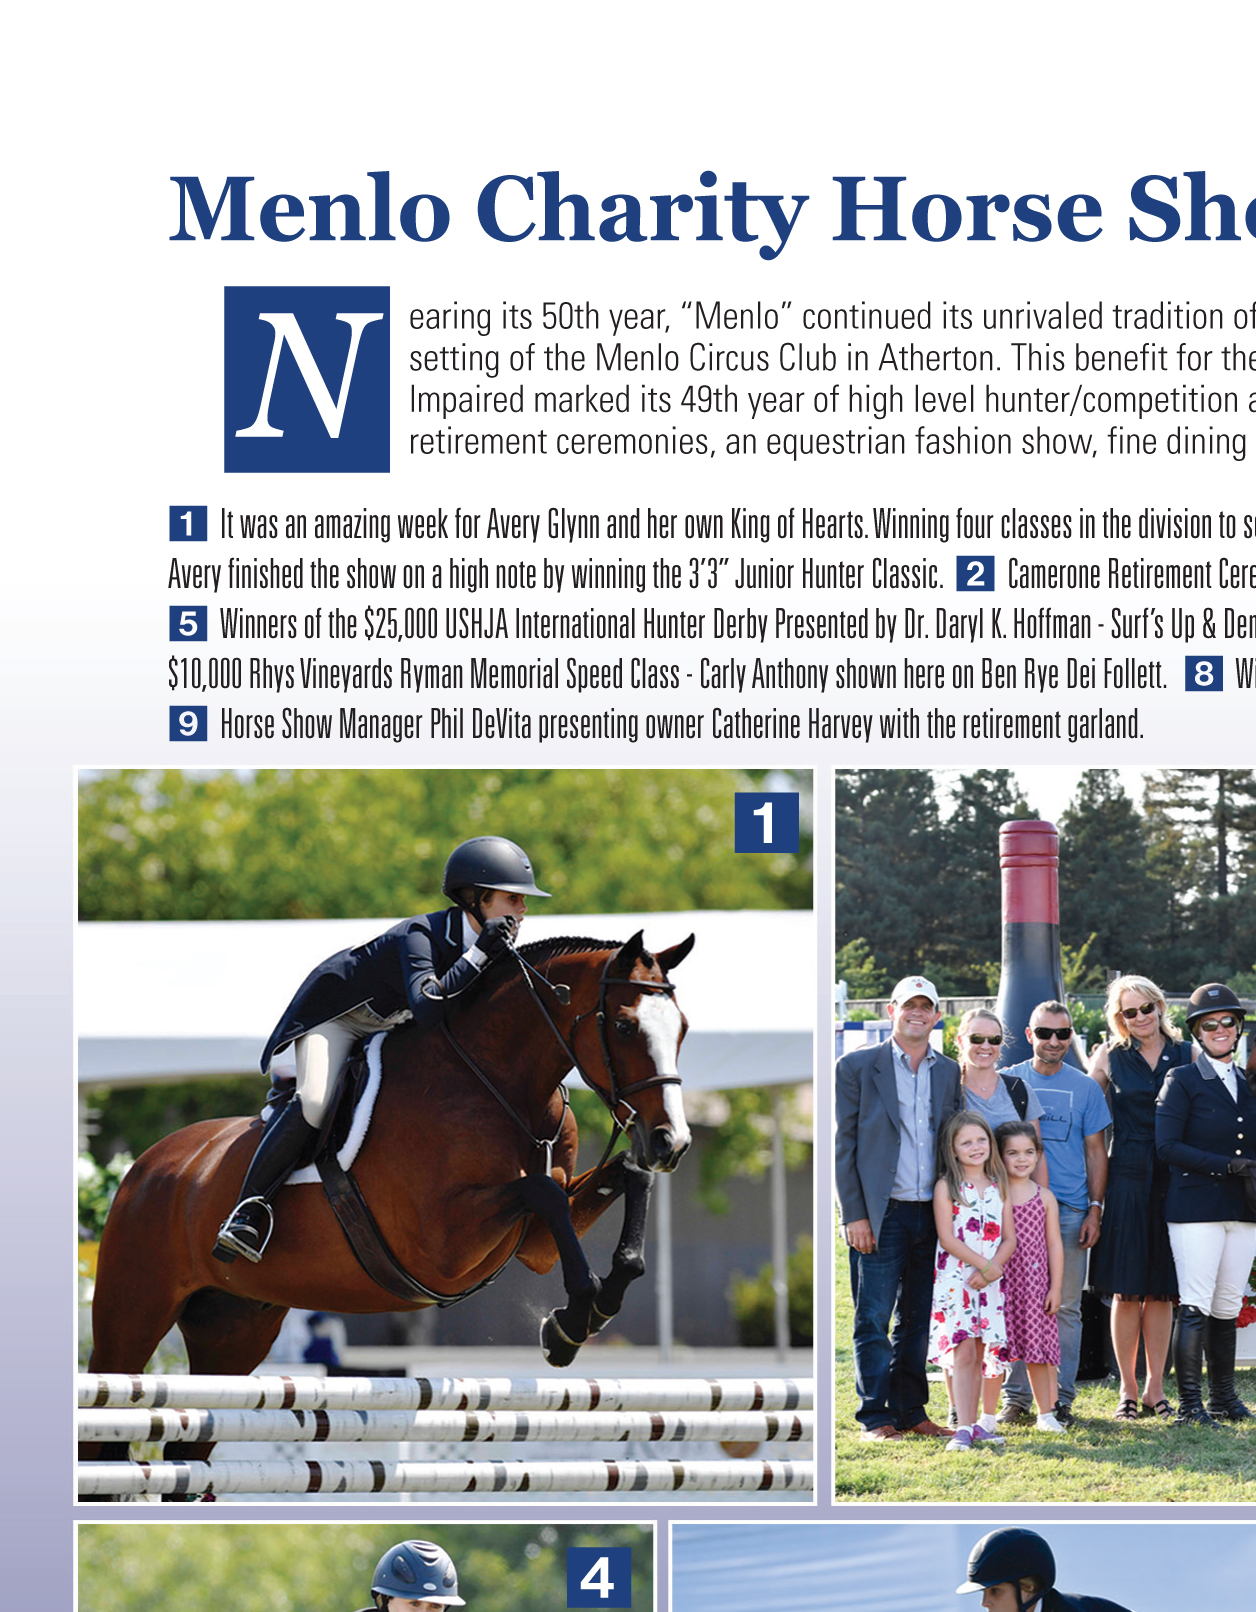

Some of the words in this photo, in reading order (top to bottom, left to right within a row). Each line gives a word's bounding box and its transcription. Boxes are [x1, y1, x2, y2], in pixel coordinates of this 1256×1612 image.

[168, 170, 451, 243] Menlo
[477, 170, 810, 261] Charity
[832, 176, 1104, 243] Horse
[409, 300, 491, 337] earing
[502, 300, 533, 330] its
[542, 300, 599, 330] 50th
[608, 308, 670, 337] year,
[681, 300, 792, 330] “Menlo”
[802, 300, 931, 330] continued
[942, 300, 973, 330] its
[983, 300, 1103, 330] unrivaled
[1112, 300, 1223, 330] tradition
[236, 313, 383, 438] N
[409, 342, 499, 379] setting
[509, 342, 536, 372] of
[543, 342, 586, 372] the
[596, 342, 679, 372] Menlo
[689, 342, 770, 372] Circus
[779, 342, 837, 372] Club
[847, 342, 869, 371] in
[878, 342, 1001, 372] Atherton.
[1010, 342, 1065, 372] This
[1075, 342, 1168, 372] benefit
[1176, 342, 1213, 372] for
[179, 711, 197, 736] 9
[221, 707, 275, 739] Horse
[281, 707, 333, 739] Show
[339, 707, 423, 744] Manager
[430, 707, 464, 739] Phil
[472, 707, 532, 739] DeVita
[538, 707, 639, 744] presenting
[645, 714, 705, 739] owner
[712, 707, 801, 739] Catherine
[808, 707, 874, 744] Harvey
[879, 707, 920, 739] with
[926, 707, 956, 739] the
[963, 707, 1062, 739] retirement
[1067, 707, 1144, 744] garland.
